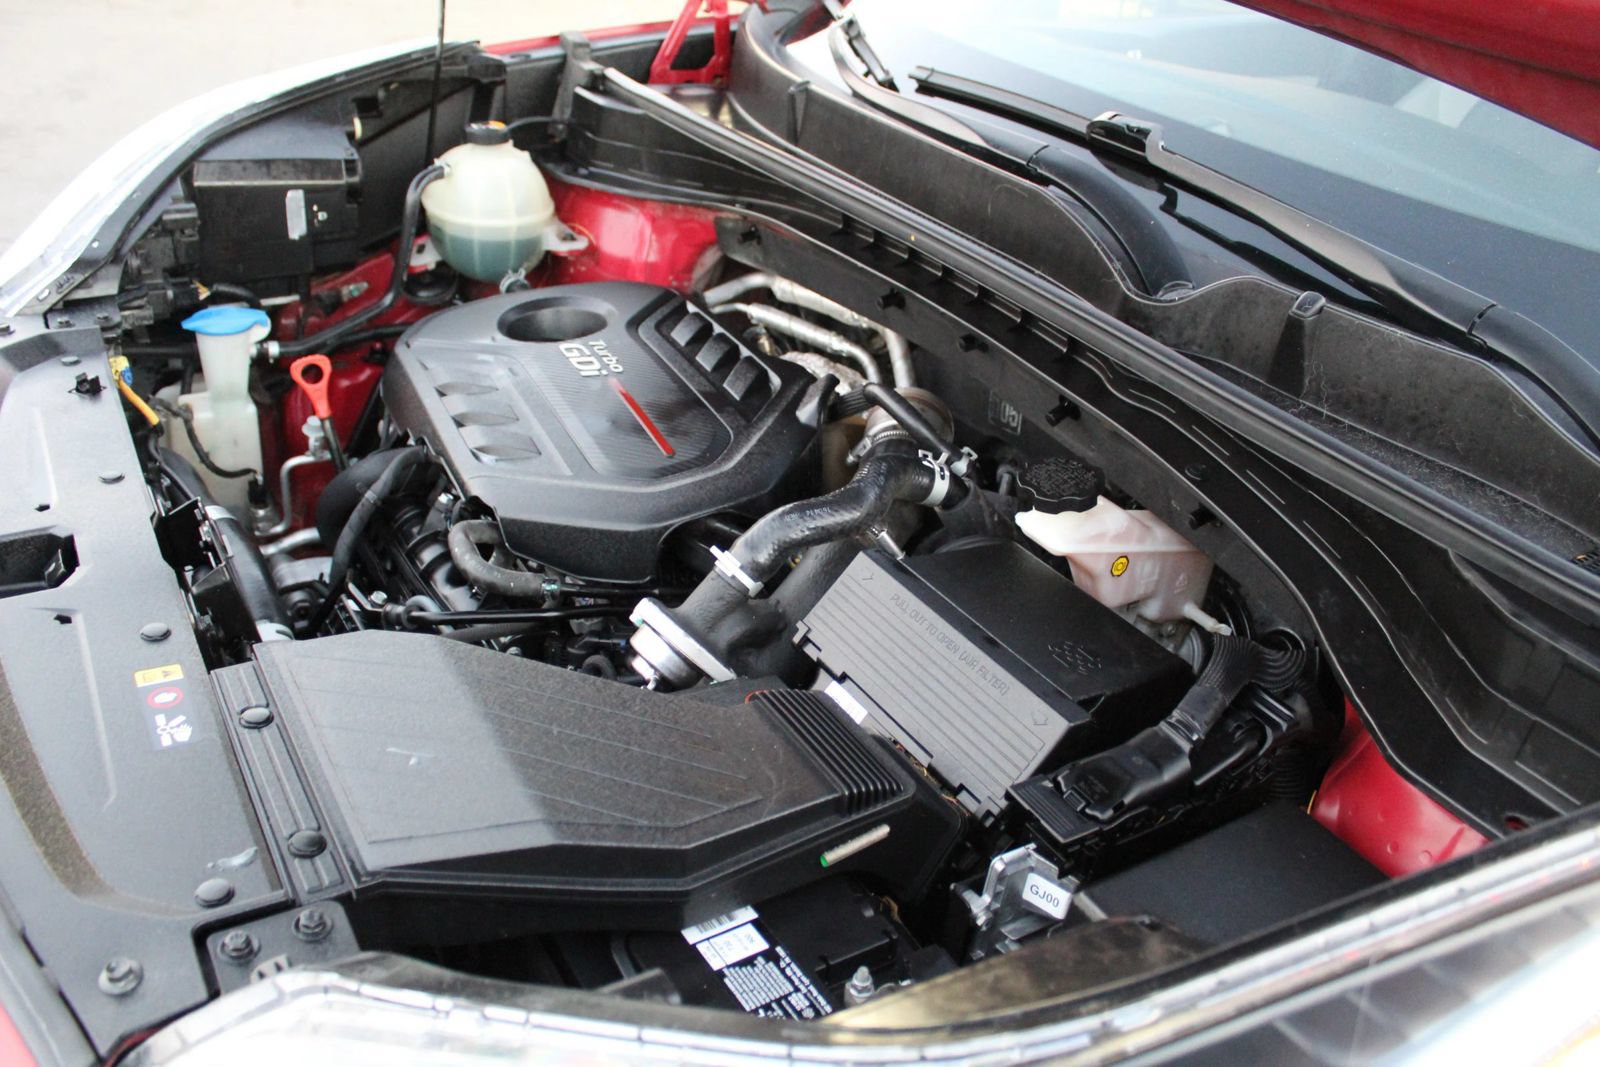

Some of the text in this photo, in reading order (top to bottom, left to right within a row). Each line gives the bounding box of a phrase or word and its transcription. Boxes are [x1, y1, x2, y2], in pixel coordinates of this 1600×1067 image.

[558, 343, 608, 377] GDi
[588, 339, 624, 373] Turbo
[890, 594, 910, 615] PULL
[909, 608, 928, 626] OUT
[926, 622, 937, 636] TO
[937, 631, 960, 654] OPEN
[1030, 884, 1060, 908] GJ00
